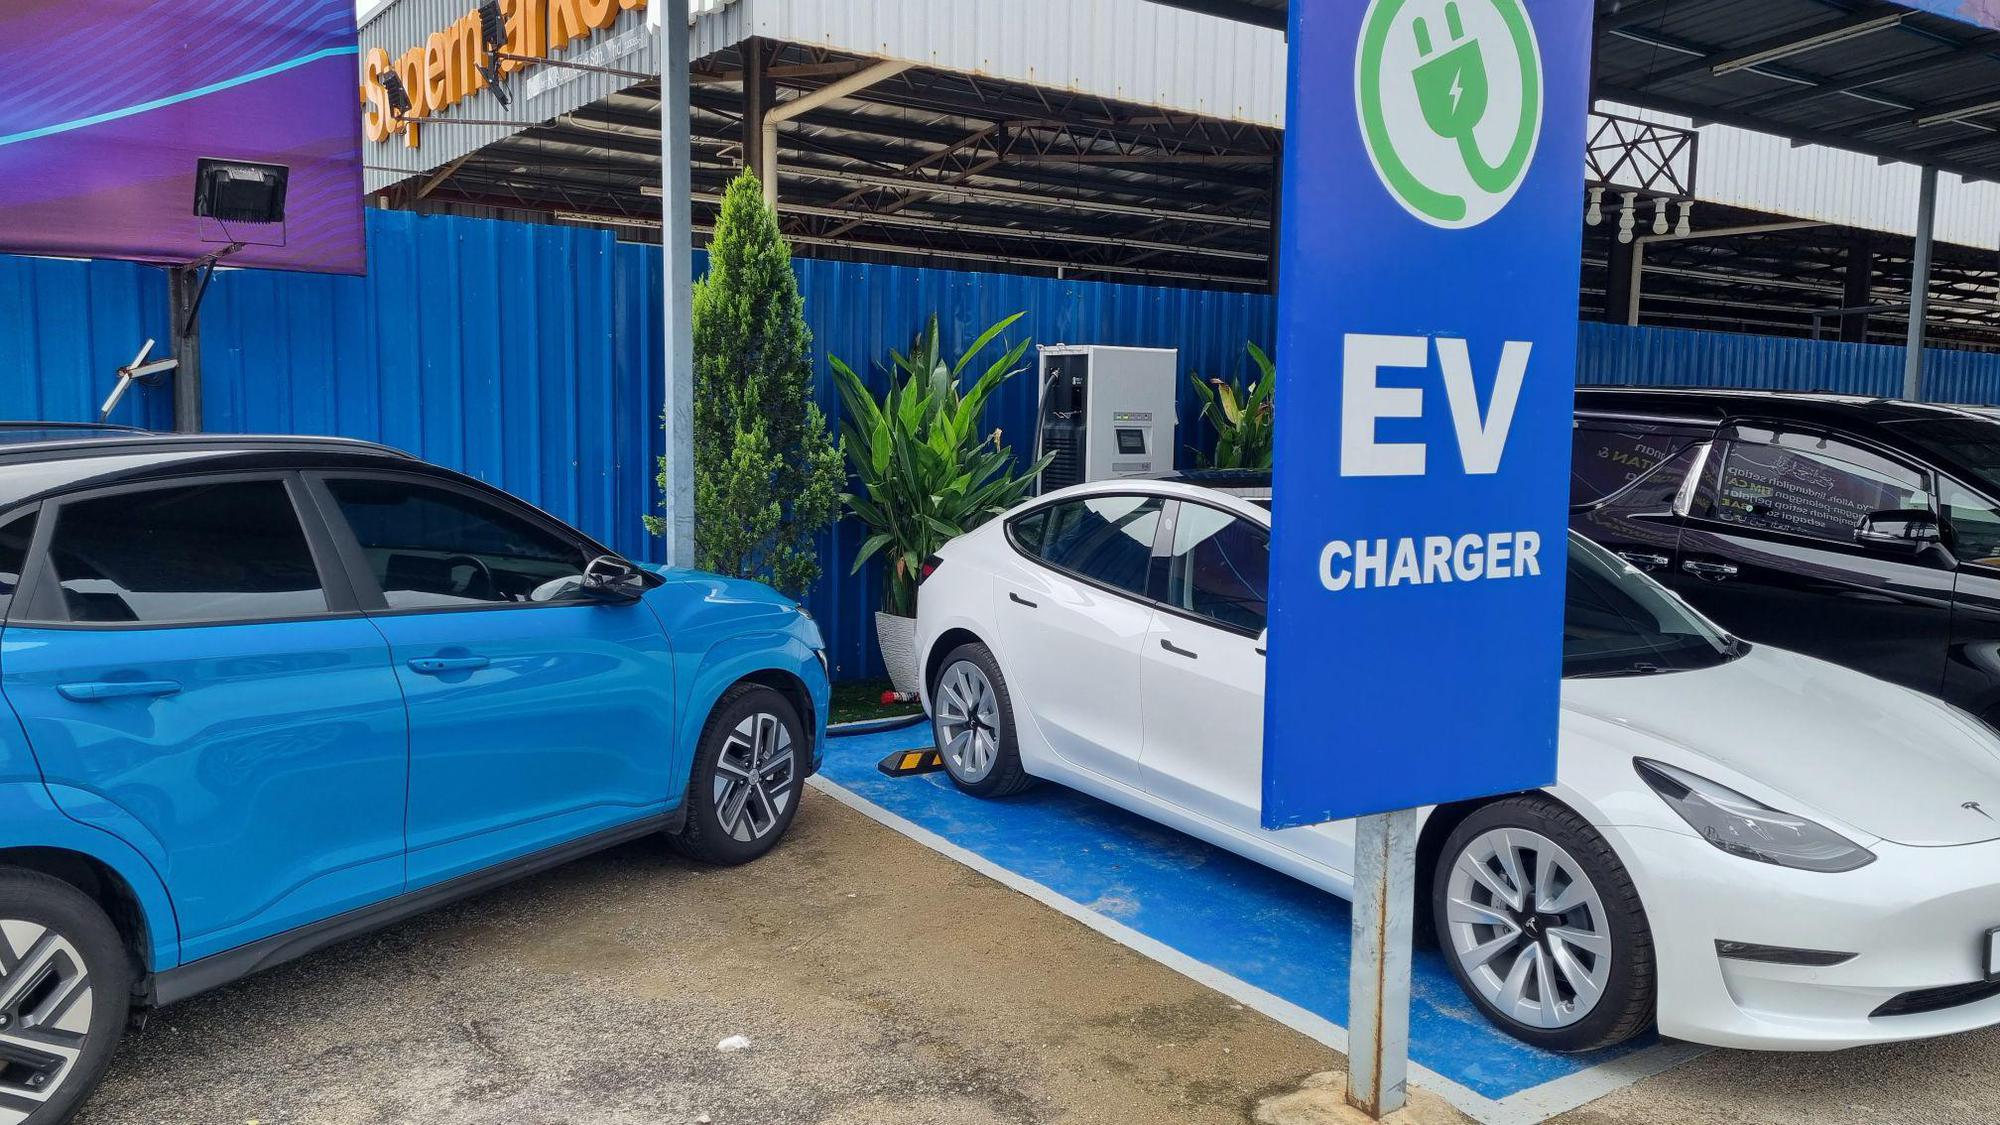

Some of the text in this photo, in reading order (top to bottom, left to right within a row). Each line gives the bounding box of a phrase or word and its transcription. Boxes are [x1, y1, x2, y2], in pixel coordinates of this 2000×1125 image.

[365, 0, 648, 149] Supermar
[1341, 333, 1534, 477] EV
[1319, 530, 1541, 592] CHARGER
